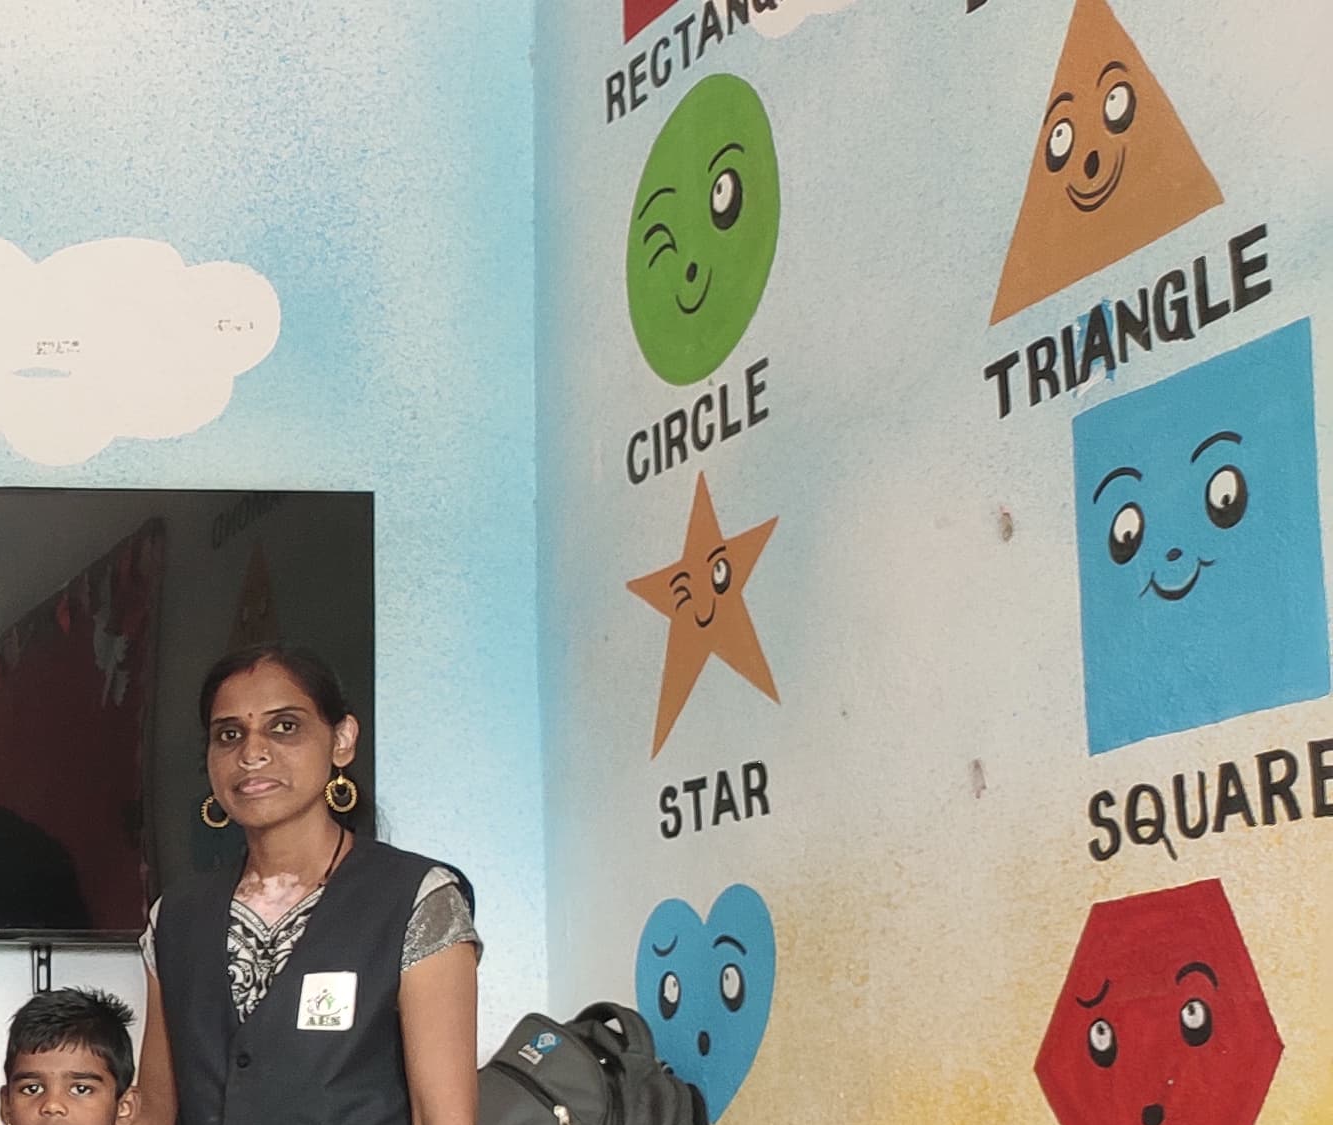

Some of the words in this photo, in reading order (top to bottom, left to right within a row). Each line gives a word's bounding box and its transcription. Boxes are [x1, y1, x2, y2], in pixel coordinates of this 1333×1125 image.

[605, 0, 779, 123] RECTAN
[983, 224, 1273, 420] TRIANGLE
[625, 357, 770, 486] CIRCLE
[659, 761, 772, 839] STAR
[1087, 737, 1333, 861] SQUARE
